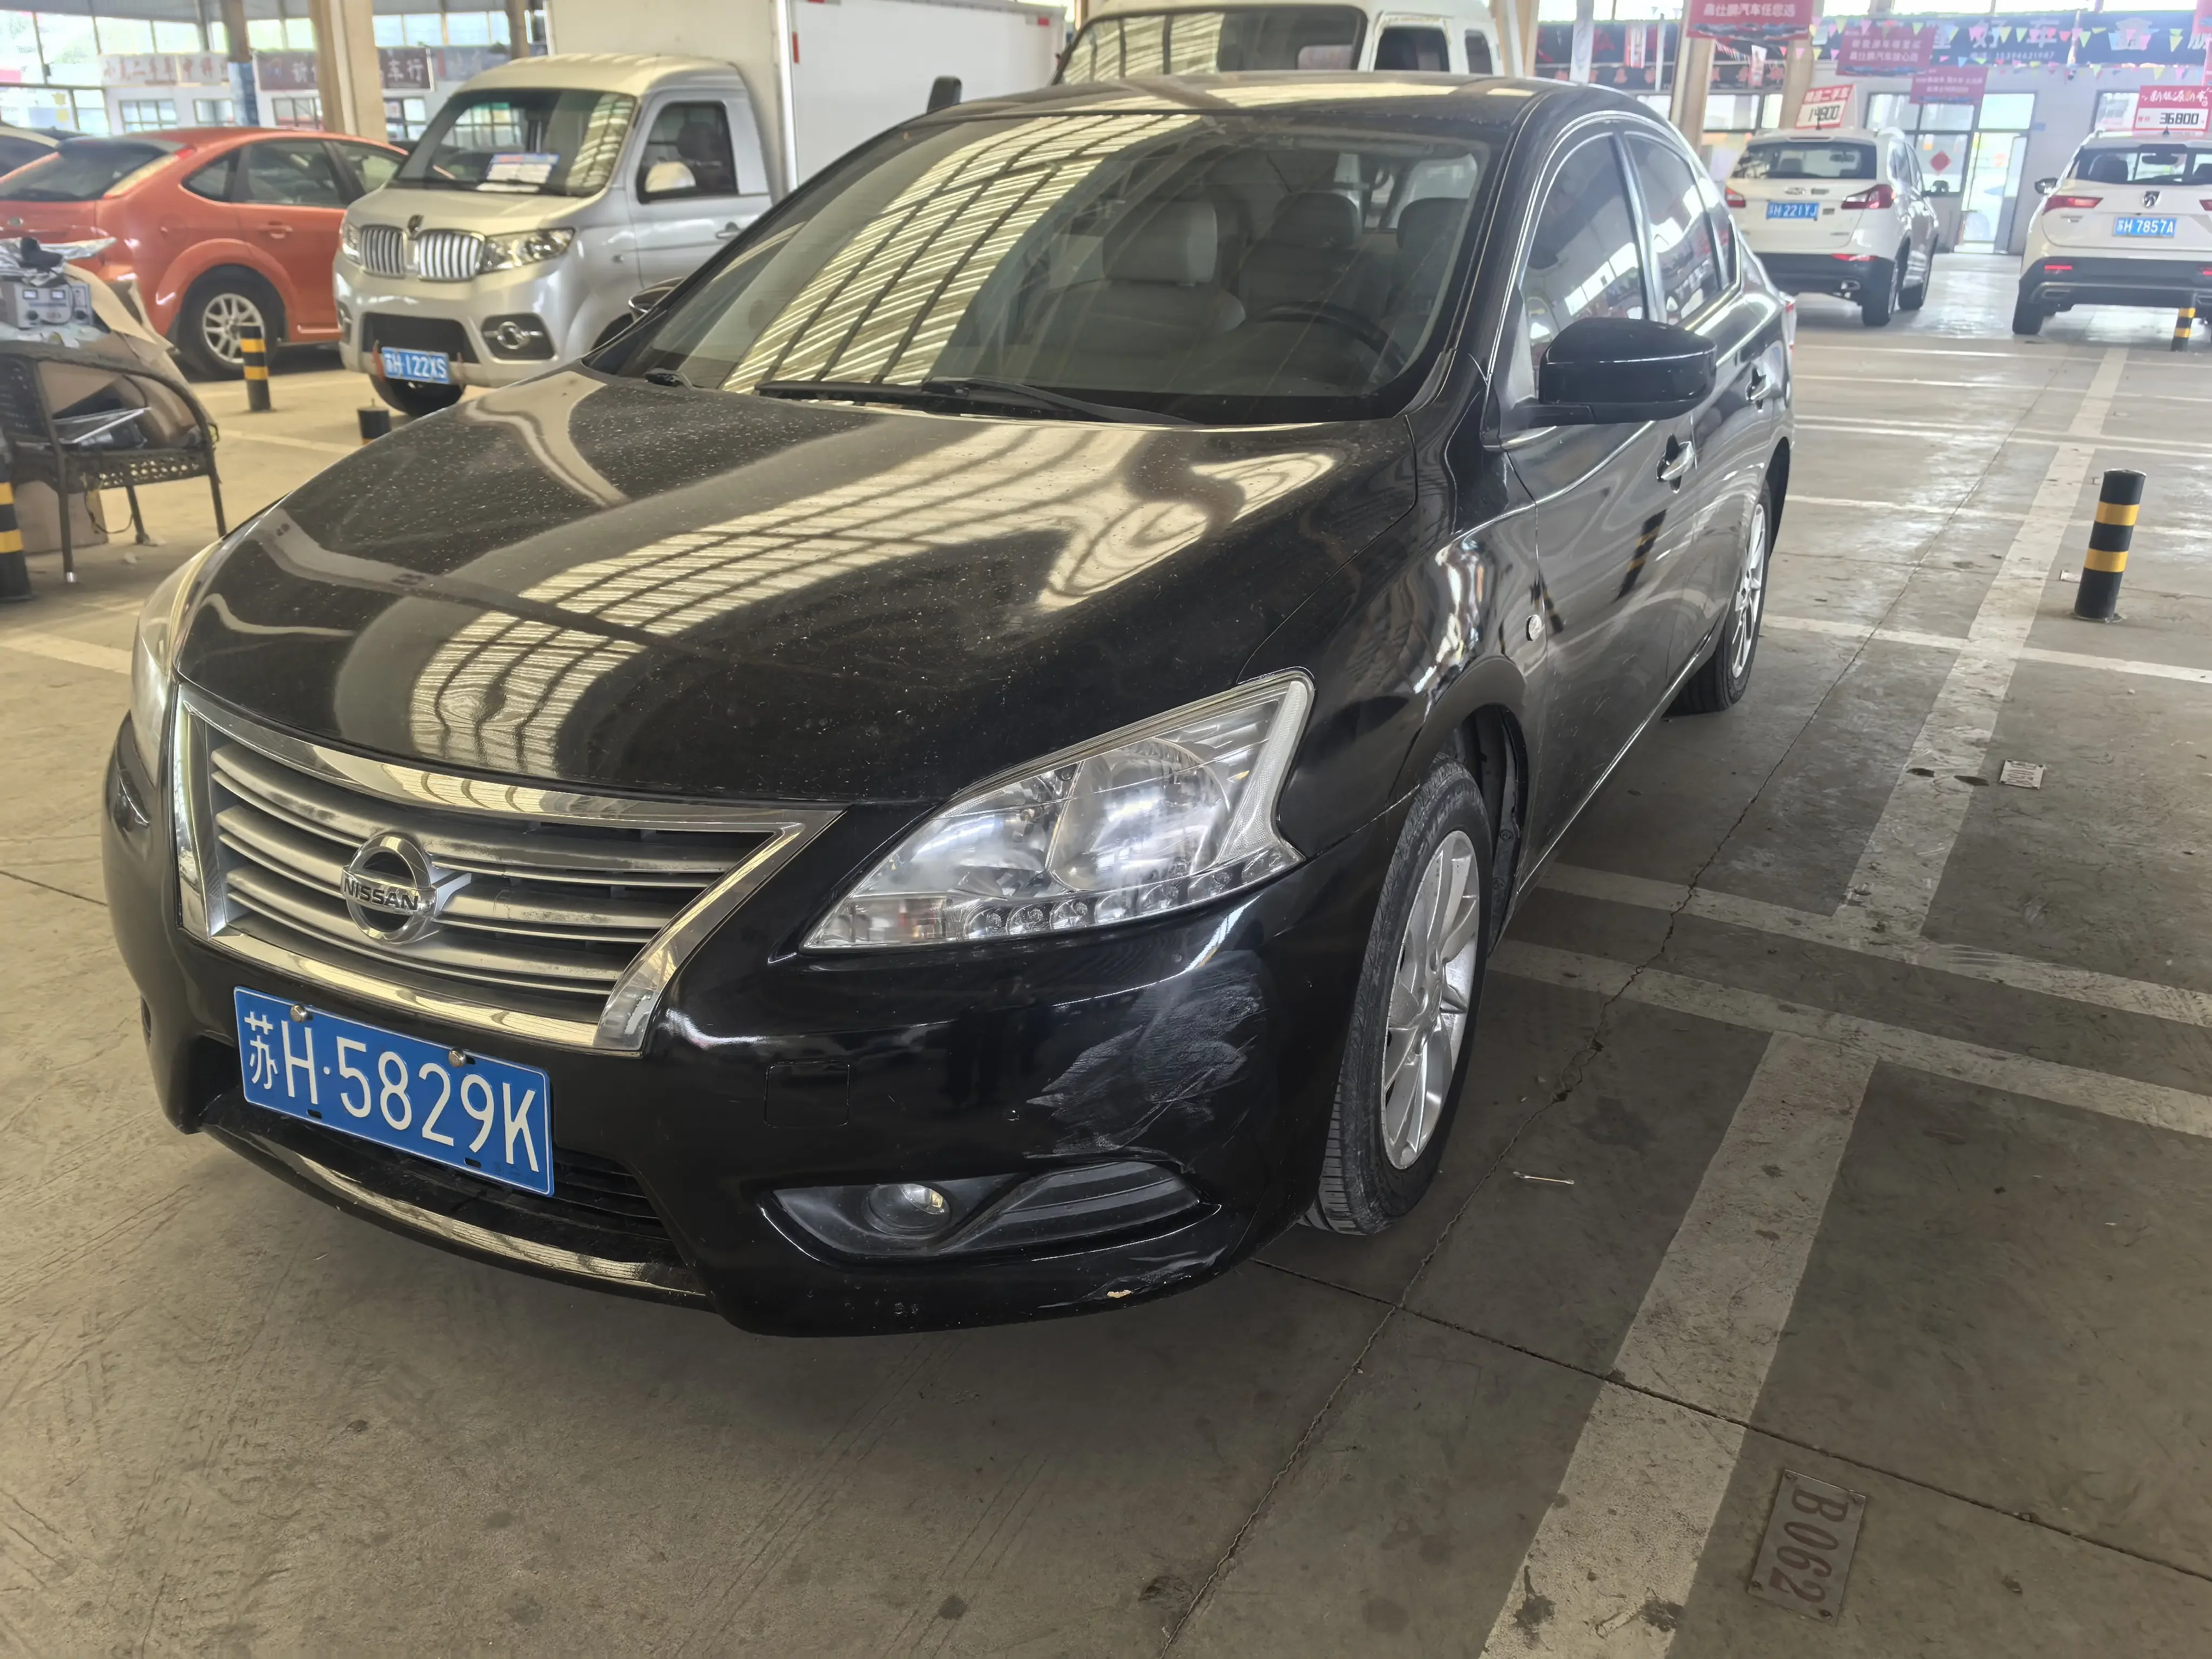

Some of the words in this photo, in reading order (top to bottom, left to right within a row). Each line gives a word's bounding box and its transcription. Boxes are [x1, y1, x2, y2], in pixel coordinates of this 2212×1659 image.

[2159, 112, 2200, 125] 36800
[344, 876, 419, 911] NISSAN
[1769, 1489, 1849, 1603] B062
